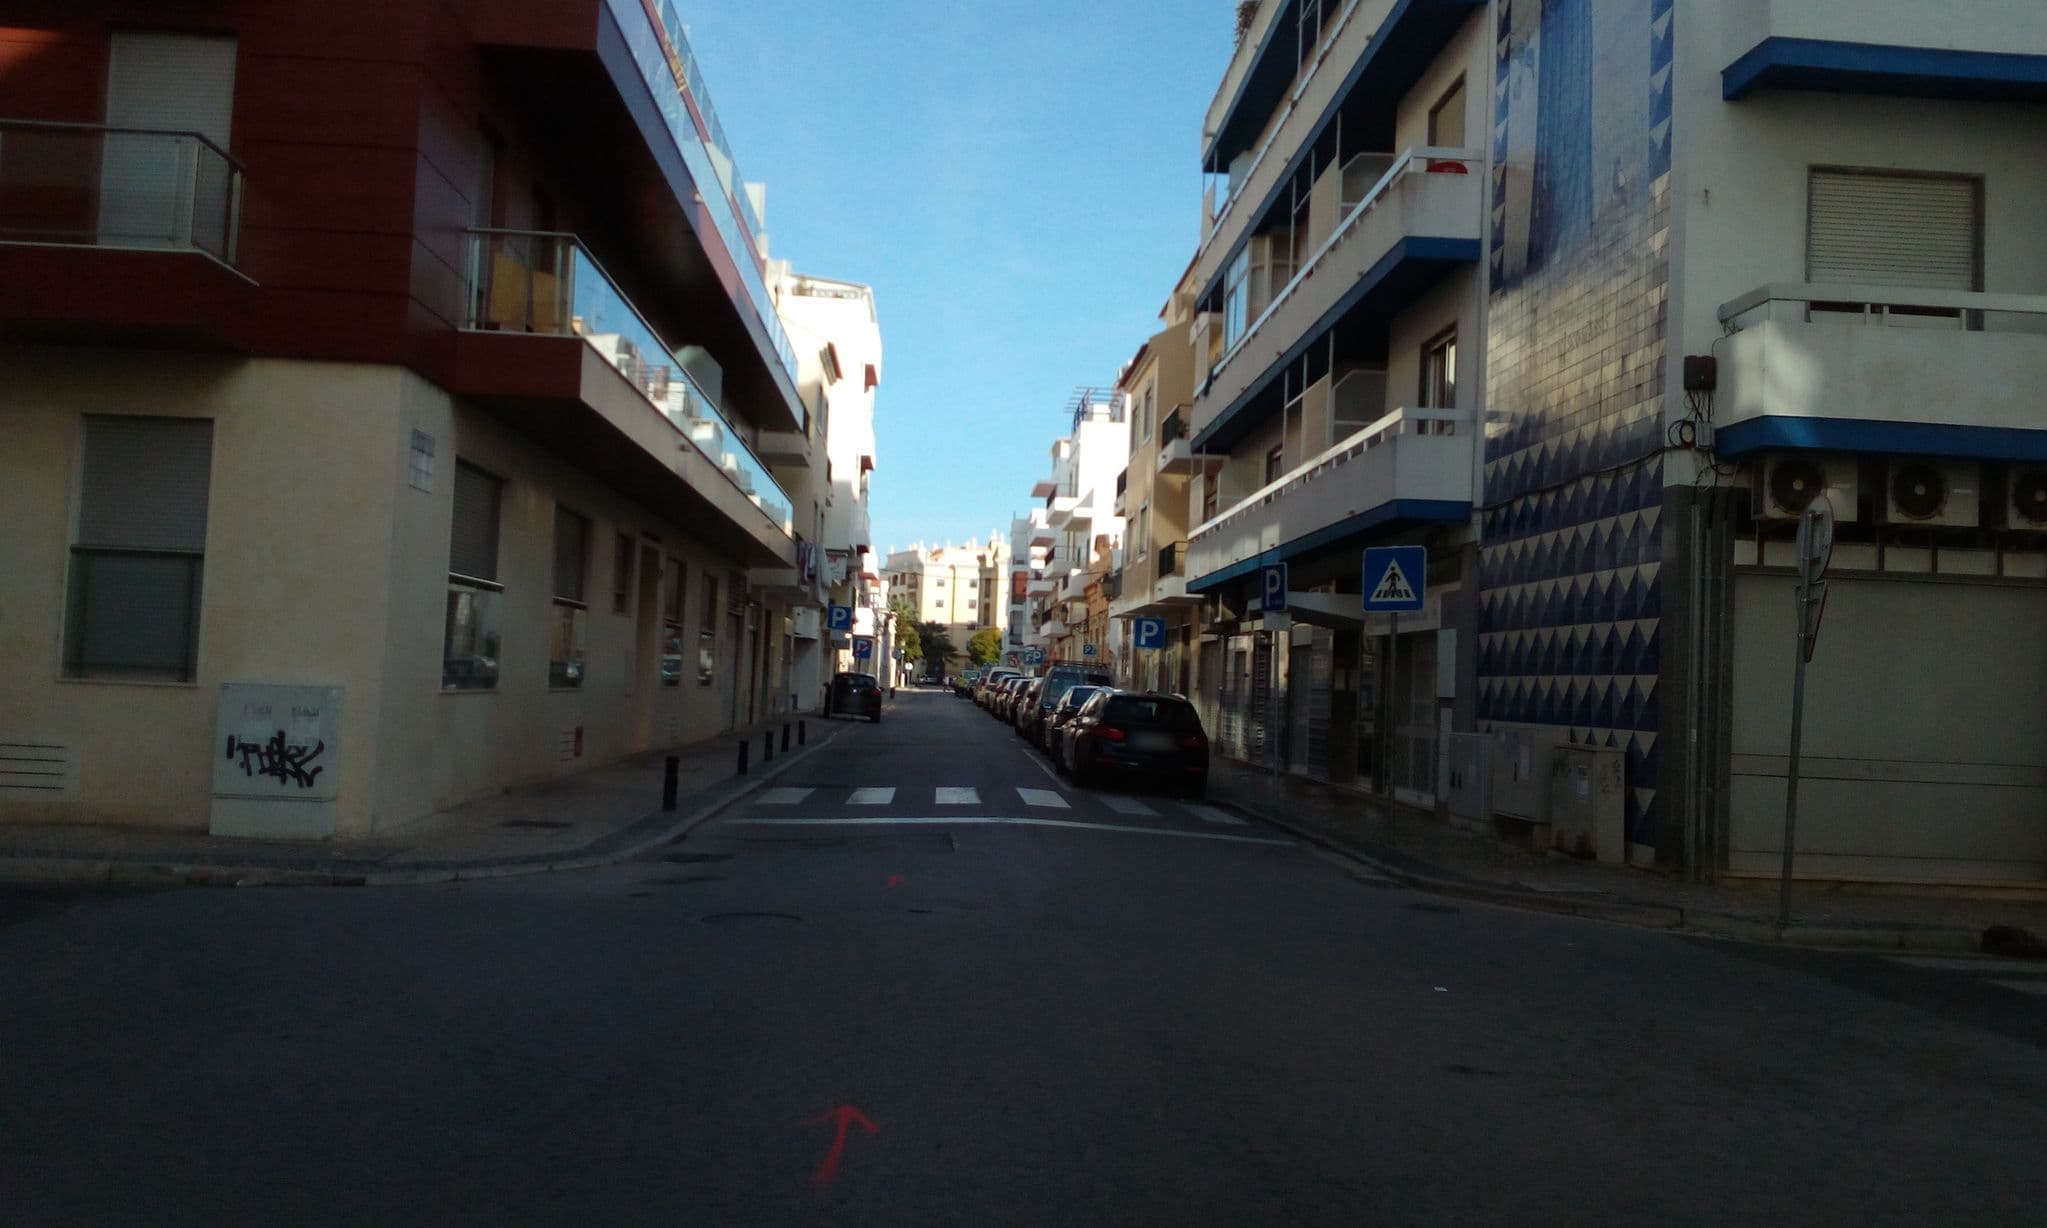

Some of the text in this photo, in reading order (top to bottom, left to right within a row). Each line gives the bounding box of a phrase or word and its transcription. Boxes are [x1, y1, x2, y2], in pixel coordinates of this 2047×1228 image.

[1265, 569, 1280, 607] P
[832, 607, 848, 627] P
[1141, 620, 1159, 645] P
[1033, 651, 1041, 664] P
